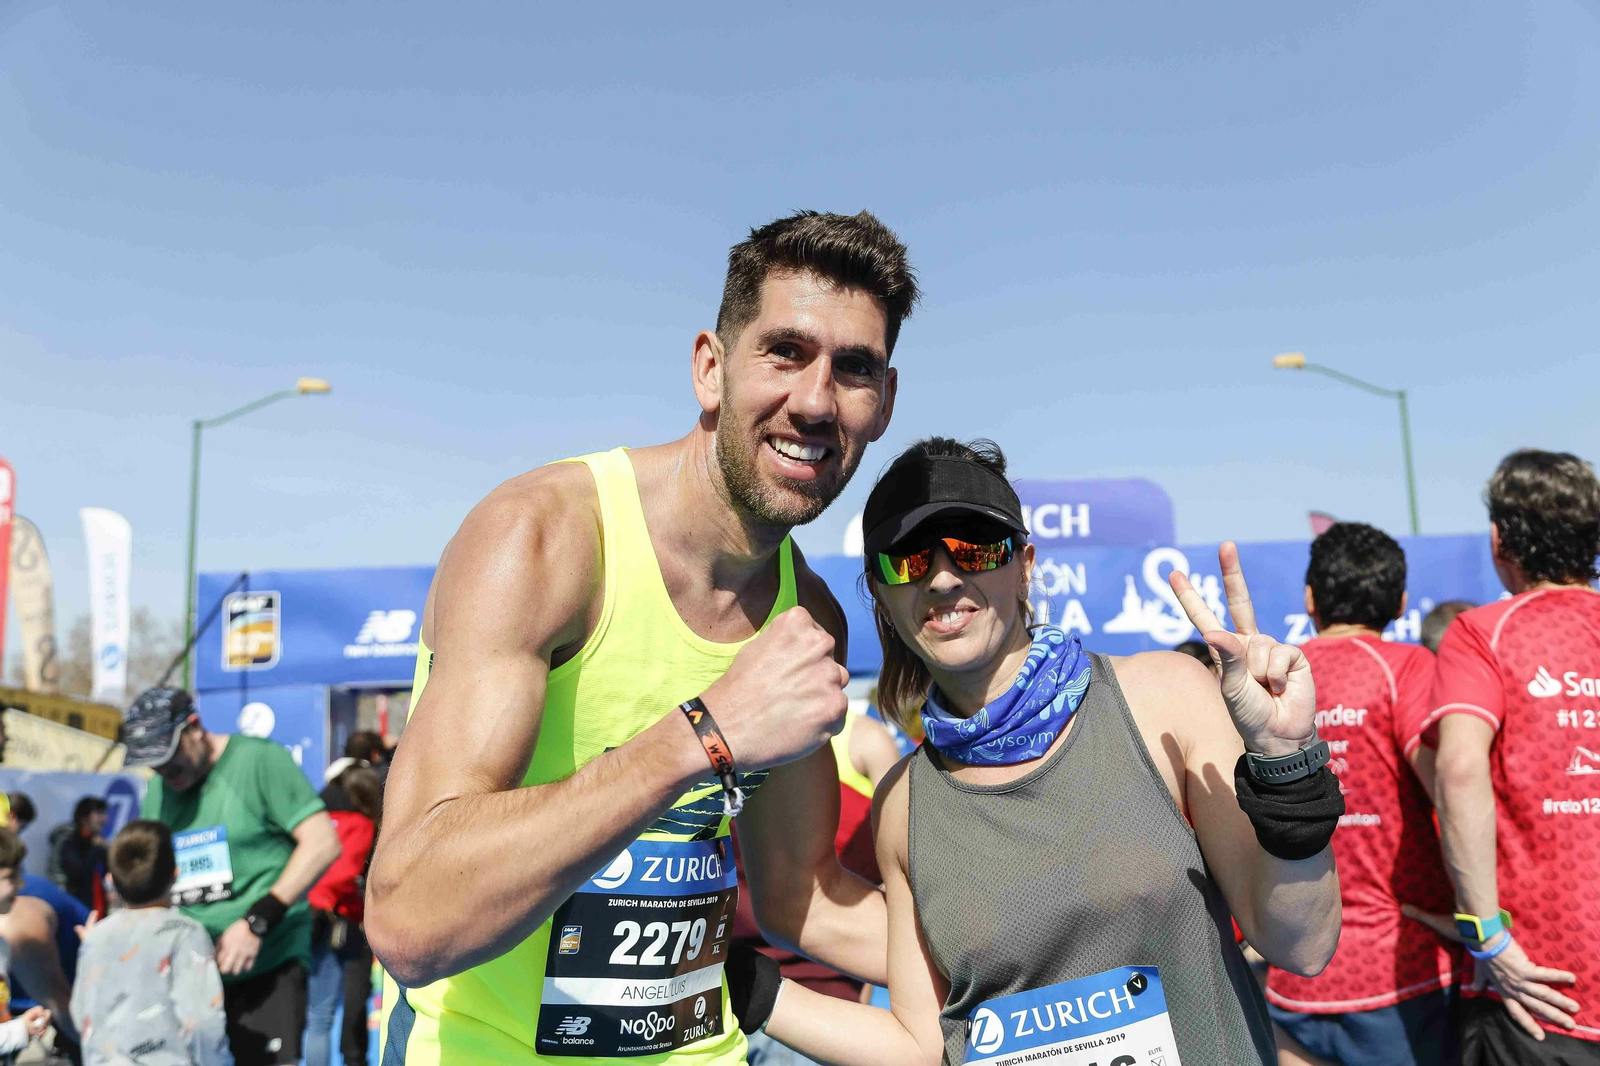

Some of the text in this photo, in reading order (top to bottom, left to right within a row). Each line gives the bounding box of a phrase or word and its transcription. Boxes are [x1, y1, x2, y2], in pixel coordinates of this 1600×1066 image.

[1020, 503, 1091, 539] ICH
[1314, 703, 1368, 728] nder
[640, 853, 723, 883] ZURICH
[608, 899, 638, 908] ZURICH
[640, 899, 678, 909] MARATÓN
[687, 897, 706, 907] SEVILLA
[706, 896, 719, 905] 2019
[608, 917, 708, 966] 2279
[621, 979, 686, 1000] ANGEL LUIS
[1010, 984, 1136, 1038] ZURICH
[562, 1036, 595, 1045] balance
[683, 1023, 707, 1042] ZURI
[1025, 1047, 1062, 1062] MARATÓN
[1064, 1045, 1074, 1054] DE
[1074, 1039, 1105, 1052] SEVILLA
[1106, 1033, 1126, 1045] 2019
[1147, 1046, 1163, 1056] ELITE
